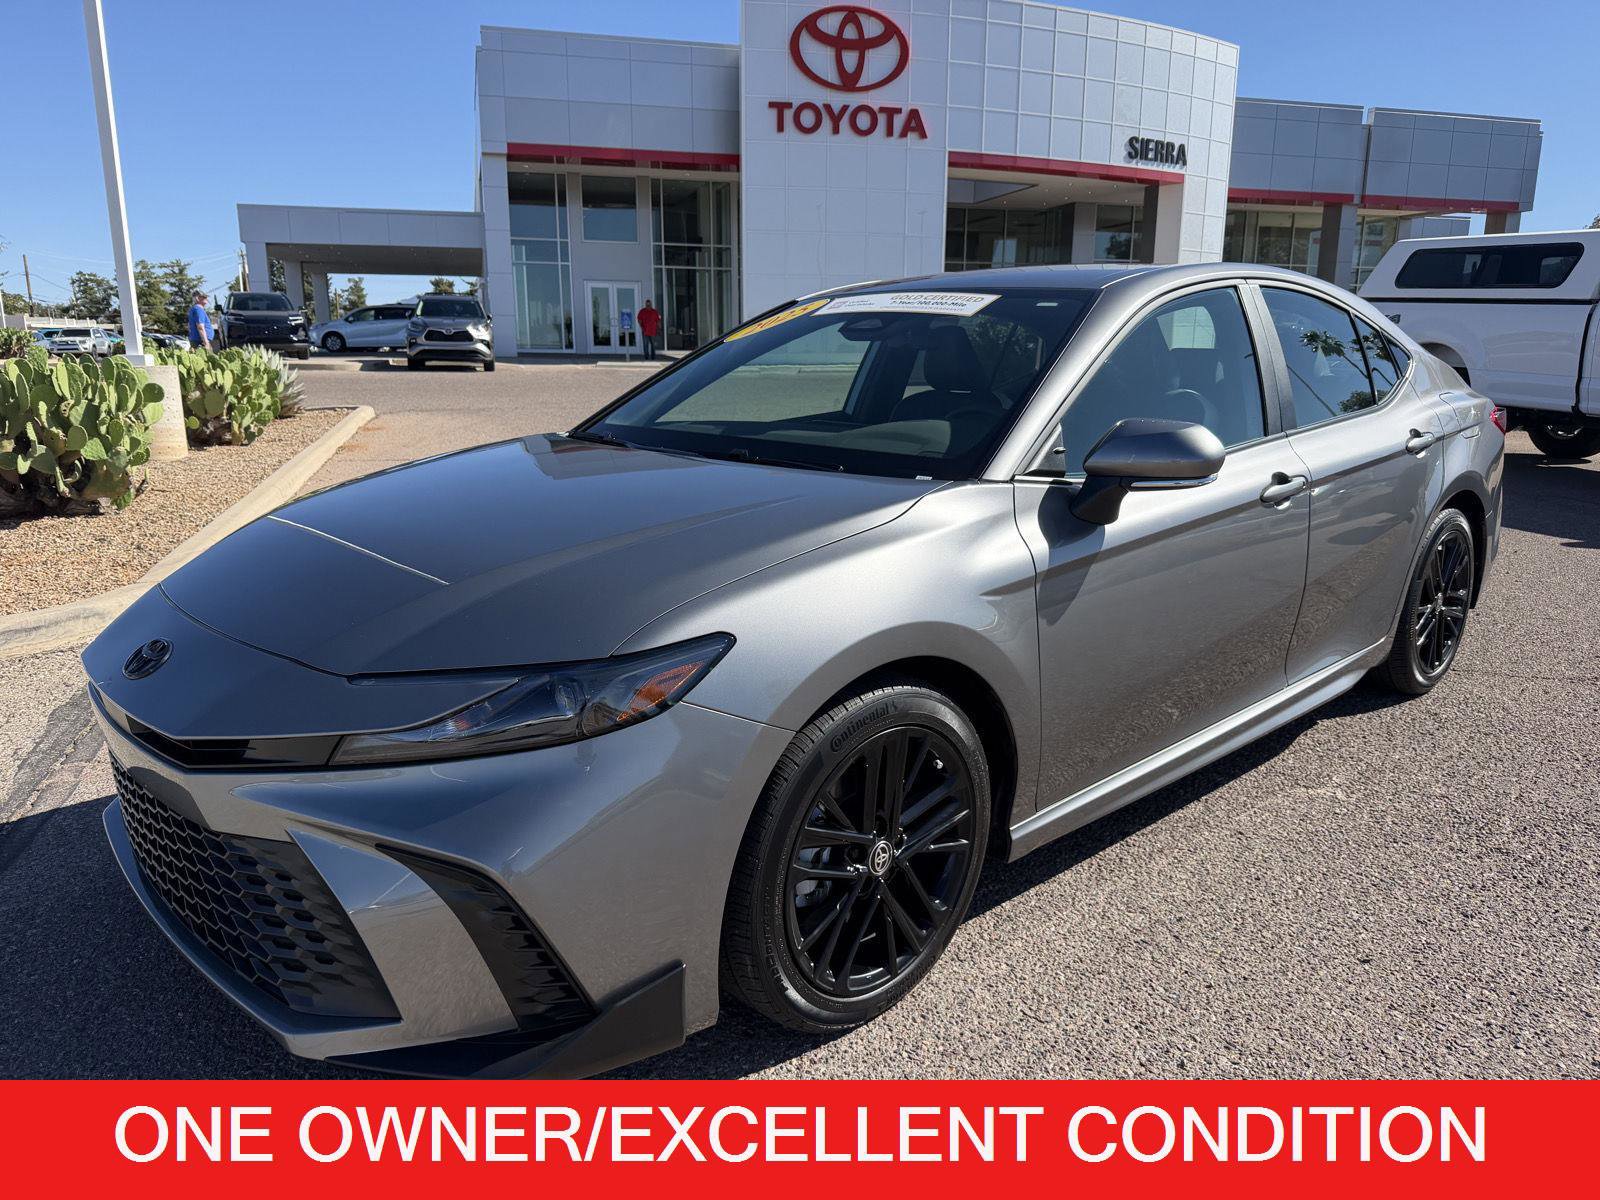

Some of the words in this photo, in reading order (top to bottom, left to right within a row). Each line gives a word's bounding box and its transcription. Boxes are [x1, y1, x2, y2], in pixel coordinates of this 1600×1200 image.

[768, 101, 928, 140] TOYOTA
[1127, 136, 1187, 166] SIERRA
[890, 294, 924, 302] GOLD
[924, 295, 985, 303] CERTIFIED
[830, 703, 890, 753] Continental
